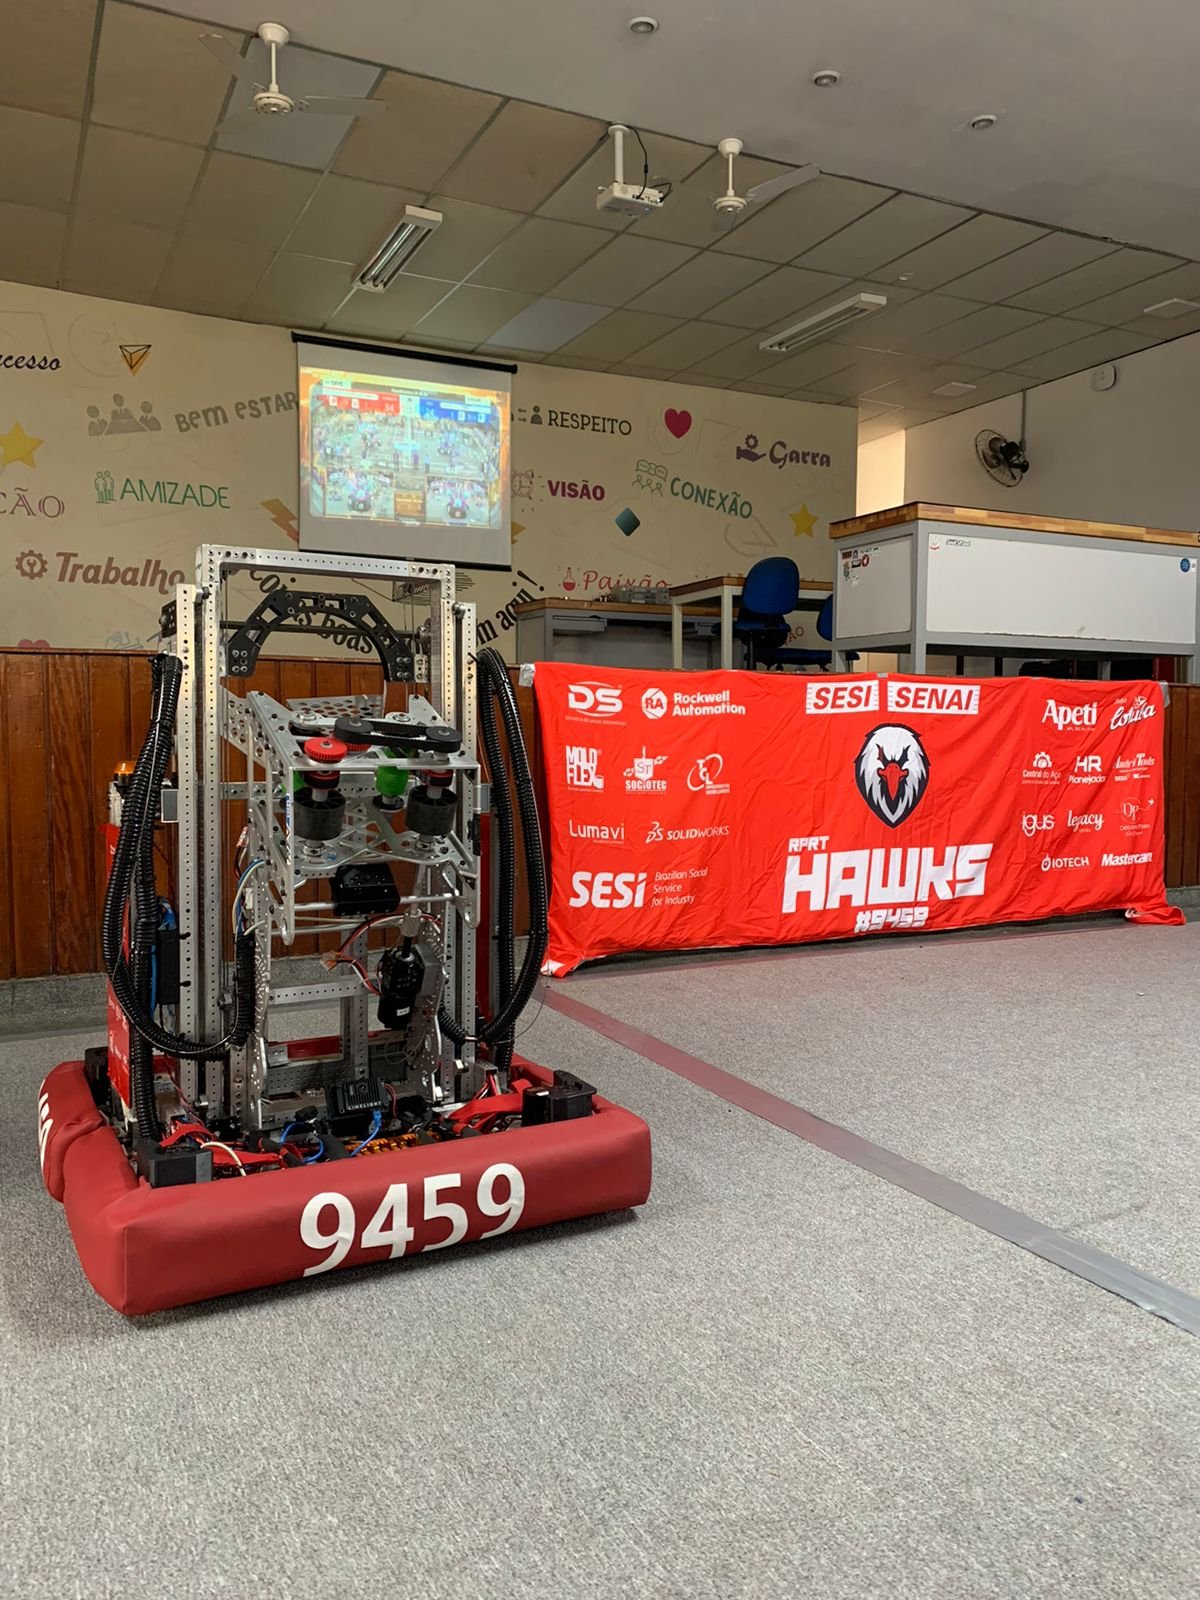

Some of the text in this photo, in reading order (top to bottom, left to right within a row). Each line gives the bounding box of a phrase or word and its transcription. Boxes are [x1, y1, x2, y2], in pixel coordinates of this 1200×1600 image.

[0, 354, 62, 371] cesso
[547, 409, 632, 436] RESPEITO
[768, 440, 831, 470] Garra
[119, 478, 231, 510] AMIZADE
[547, 479, 606, 502] VISÃO
[669, 476, 753, 520] CONEXÃO
[56, 551, 186, 596] Trabalho
[567, 684, 623, 713] DS
[645, 697, 665, 710] RA
[673, 690, 730, 704] Rockwell
[813, 685, 974, 711] SESI SENAI
[672, 702, 746, 717] Automation
[1041, 698, 1098, 731] Apeti
[566, 745, 598, 765] MOLD
[1074, 755, 1102, 773] HR
[566, 764, 598, 787] FLEX
[569, 819, 625, 840] Lumavi
[667, 825, 730, 841] SOLIDWORKS
[1022, 811, 1055, 837] igus
[788, 836, 830, 852] RPRT
[655, 871, 688, 881] Brazilian
[782, 843, 994, 914] HAWKS
[653, 883, 683, 894] Service
[854, 906, 930, 934] #9459
[300, 1162, 526, 1278] 9459
